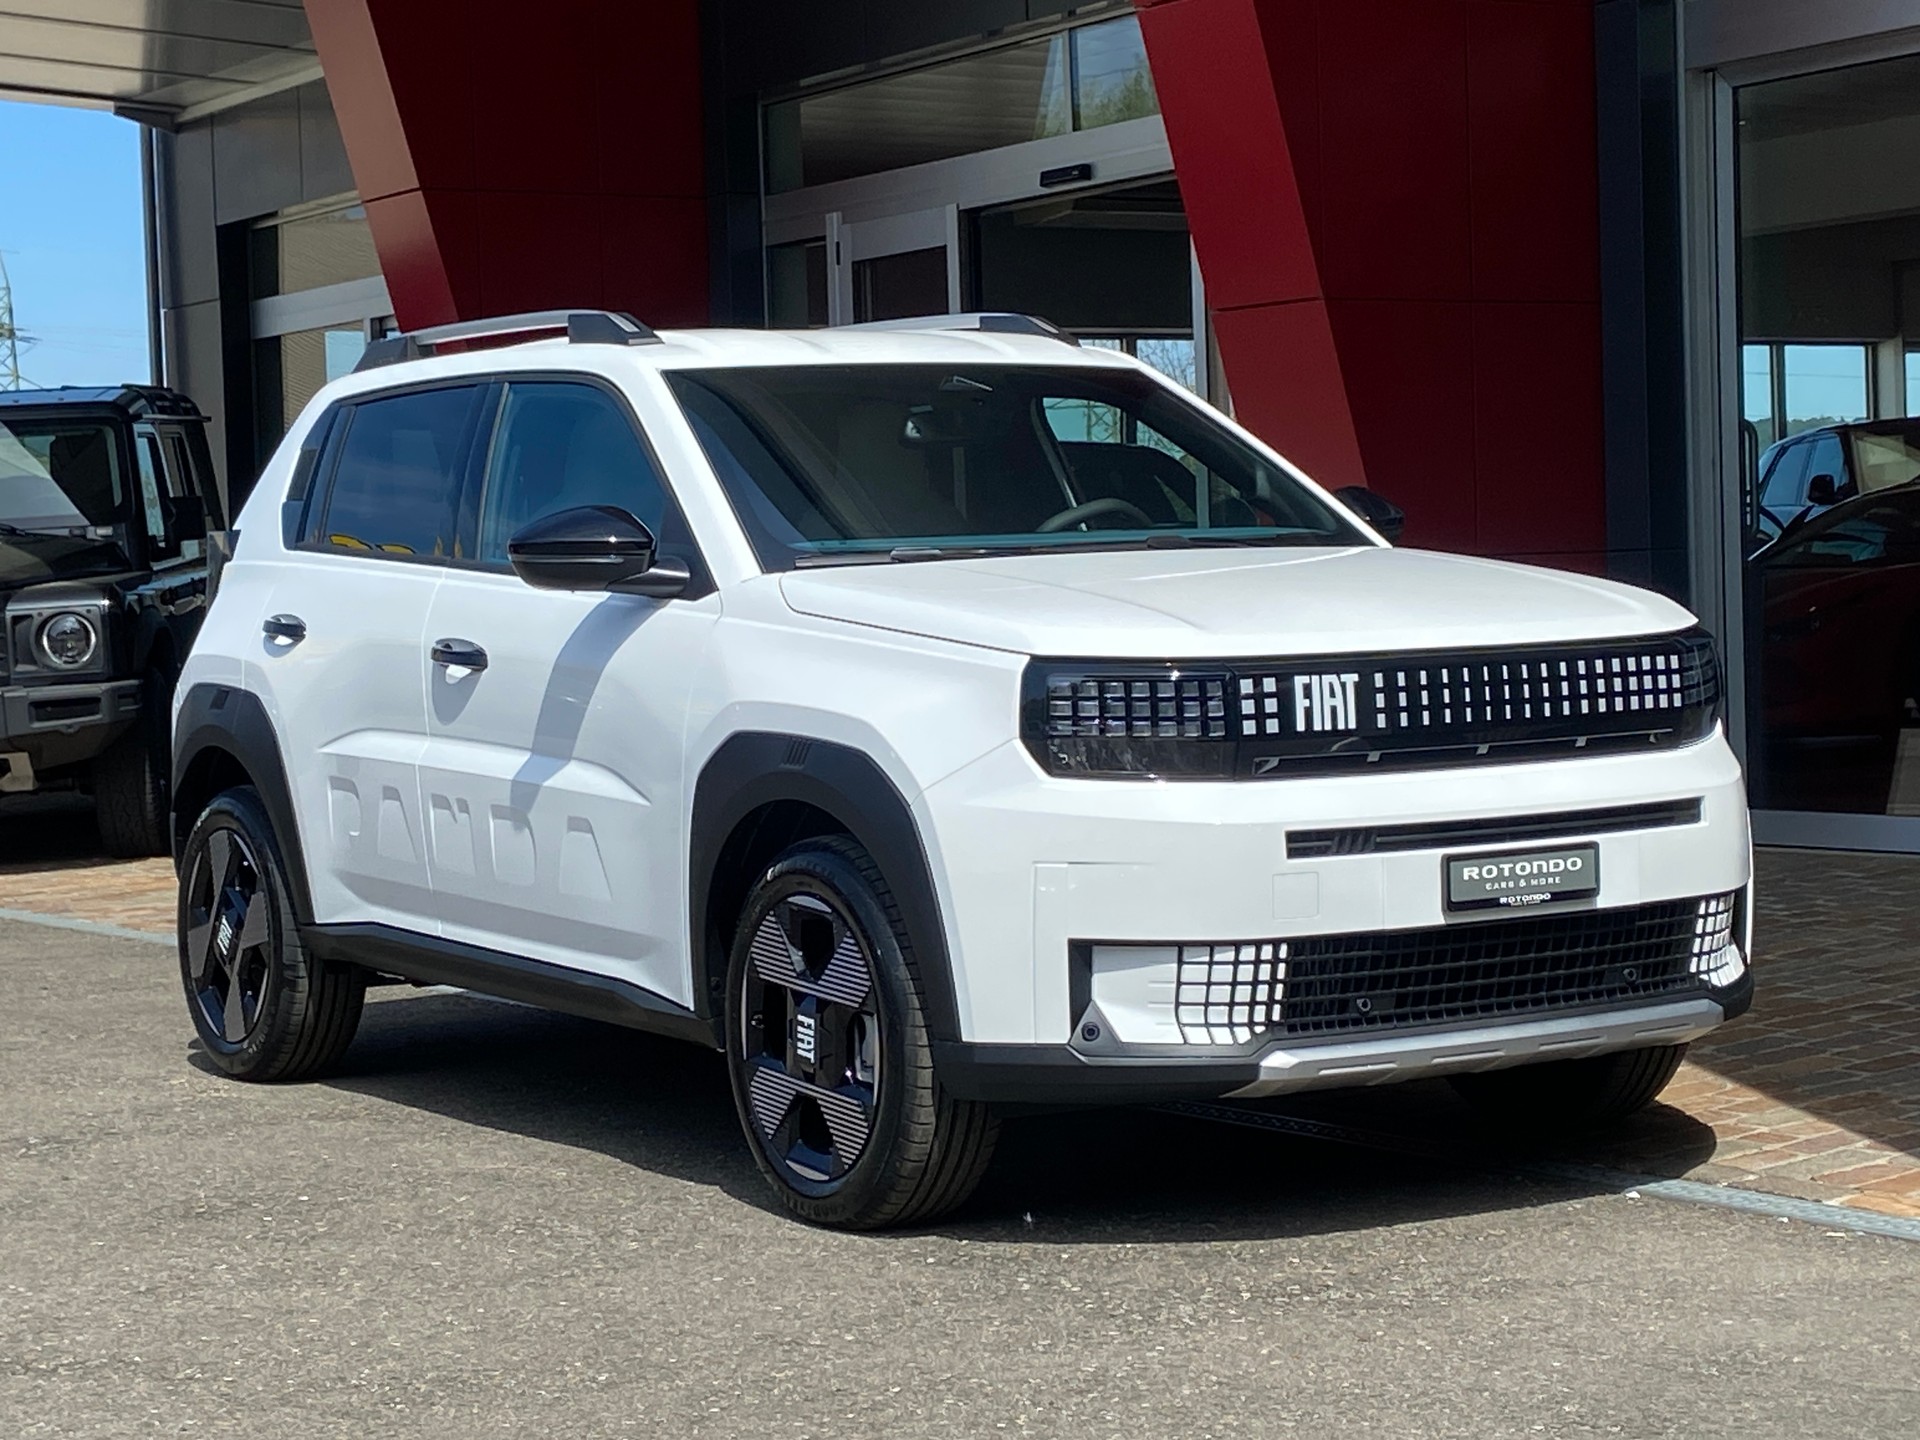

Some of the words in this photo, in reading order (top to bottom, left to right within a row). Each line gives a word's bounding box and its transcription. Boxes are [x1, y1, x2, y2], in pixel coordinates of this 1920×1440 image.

[1294, 673, 1359, 732] FIAT
[327, 775, 616, 902] PANDA
[1463, 857, 1583, 880] ROTONDO
[1485, 881, 1515, 891] CARS
[1519, 879, 1526, 887] &
[1530, 876, 1561, 886] MORE
[797, 1014, 815, 1064] FIAT
